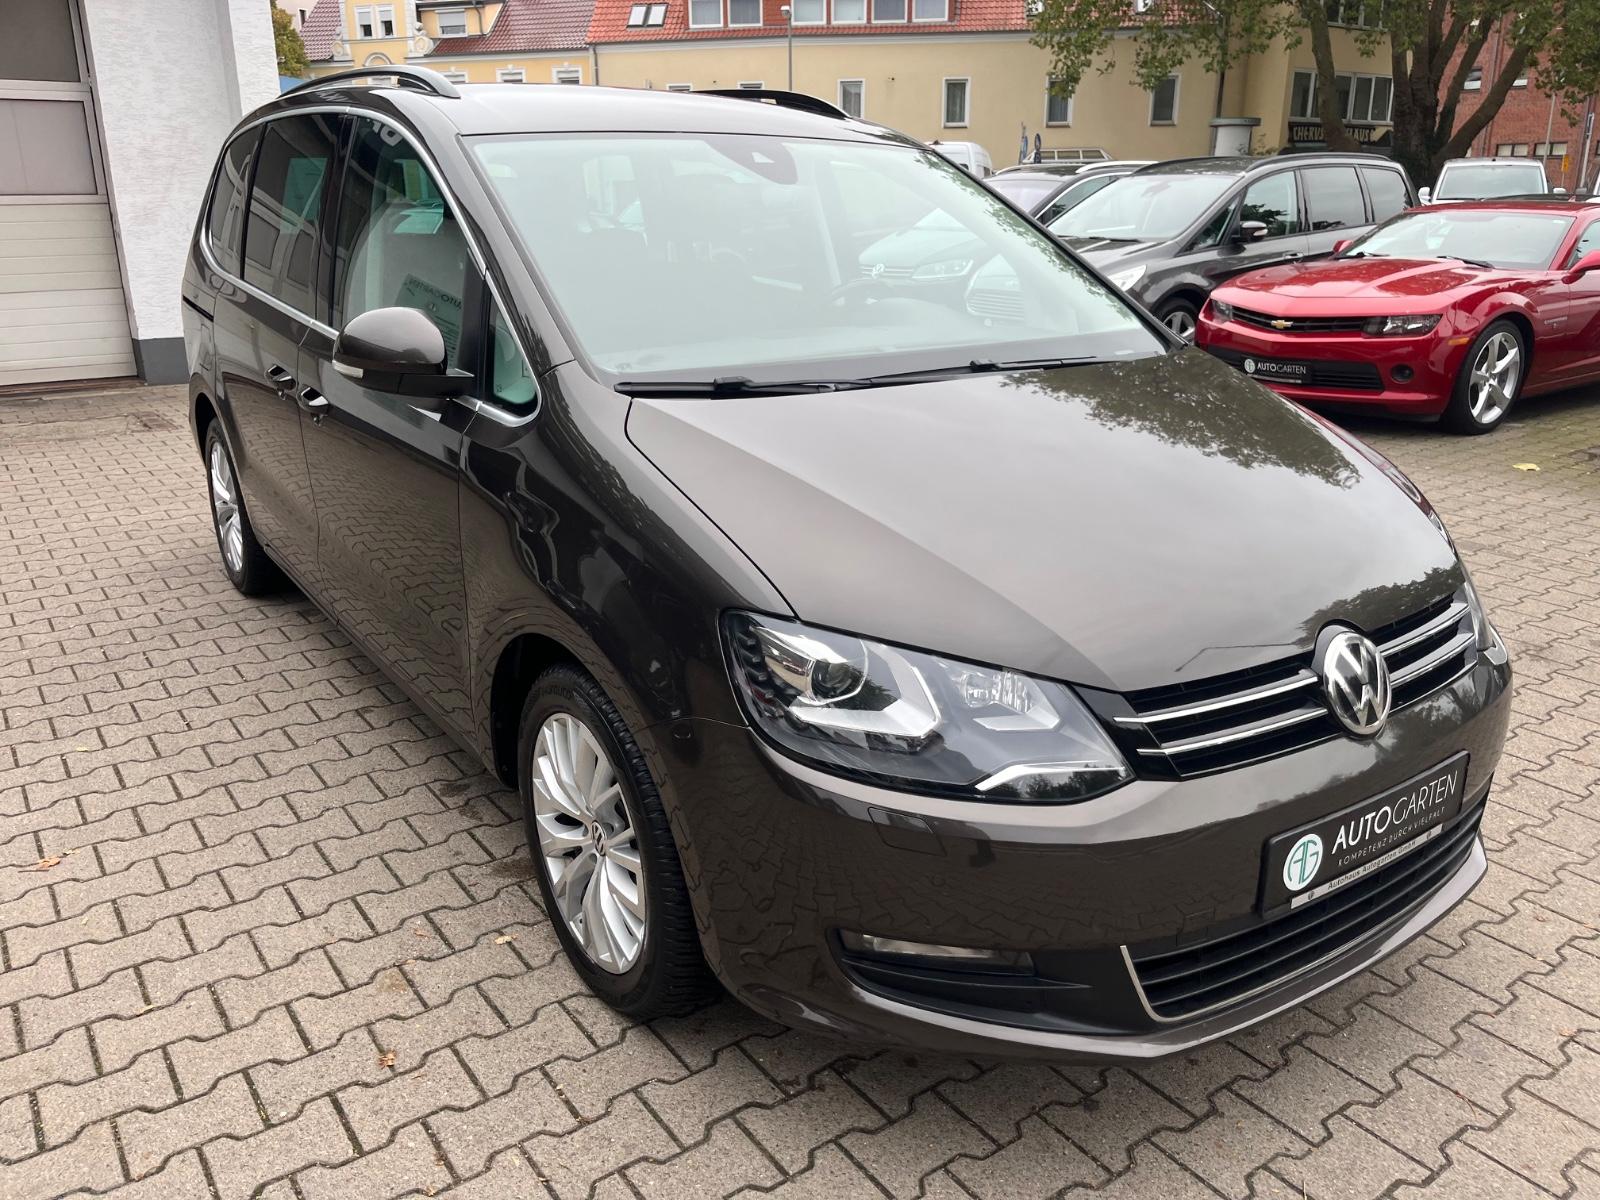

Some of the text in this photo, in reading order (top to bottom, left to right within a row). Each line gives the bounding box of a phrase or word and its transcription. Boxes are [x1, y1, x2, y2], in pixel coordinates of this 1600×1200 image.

[1331, 770, 1458, 855] AUTOGARTEN
[1327, 841, 1416, 890] Autohaus Autogarten GmbH
